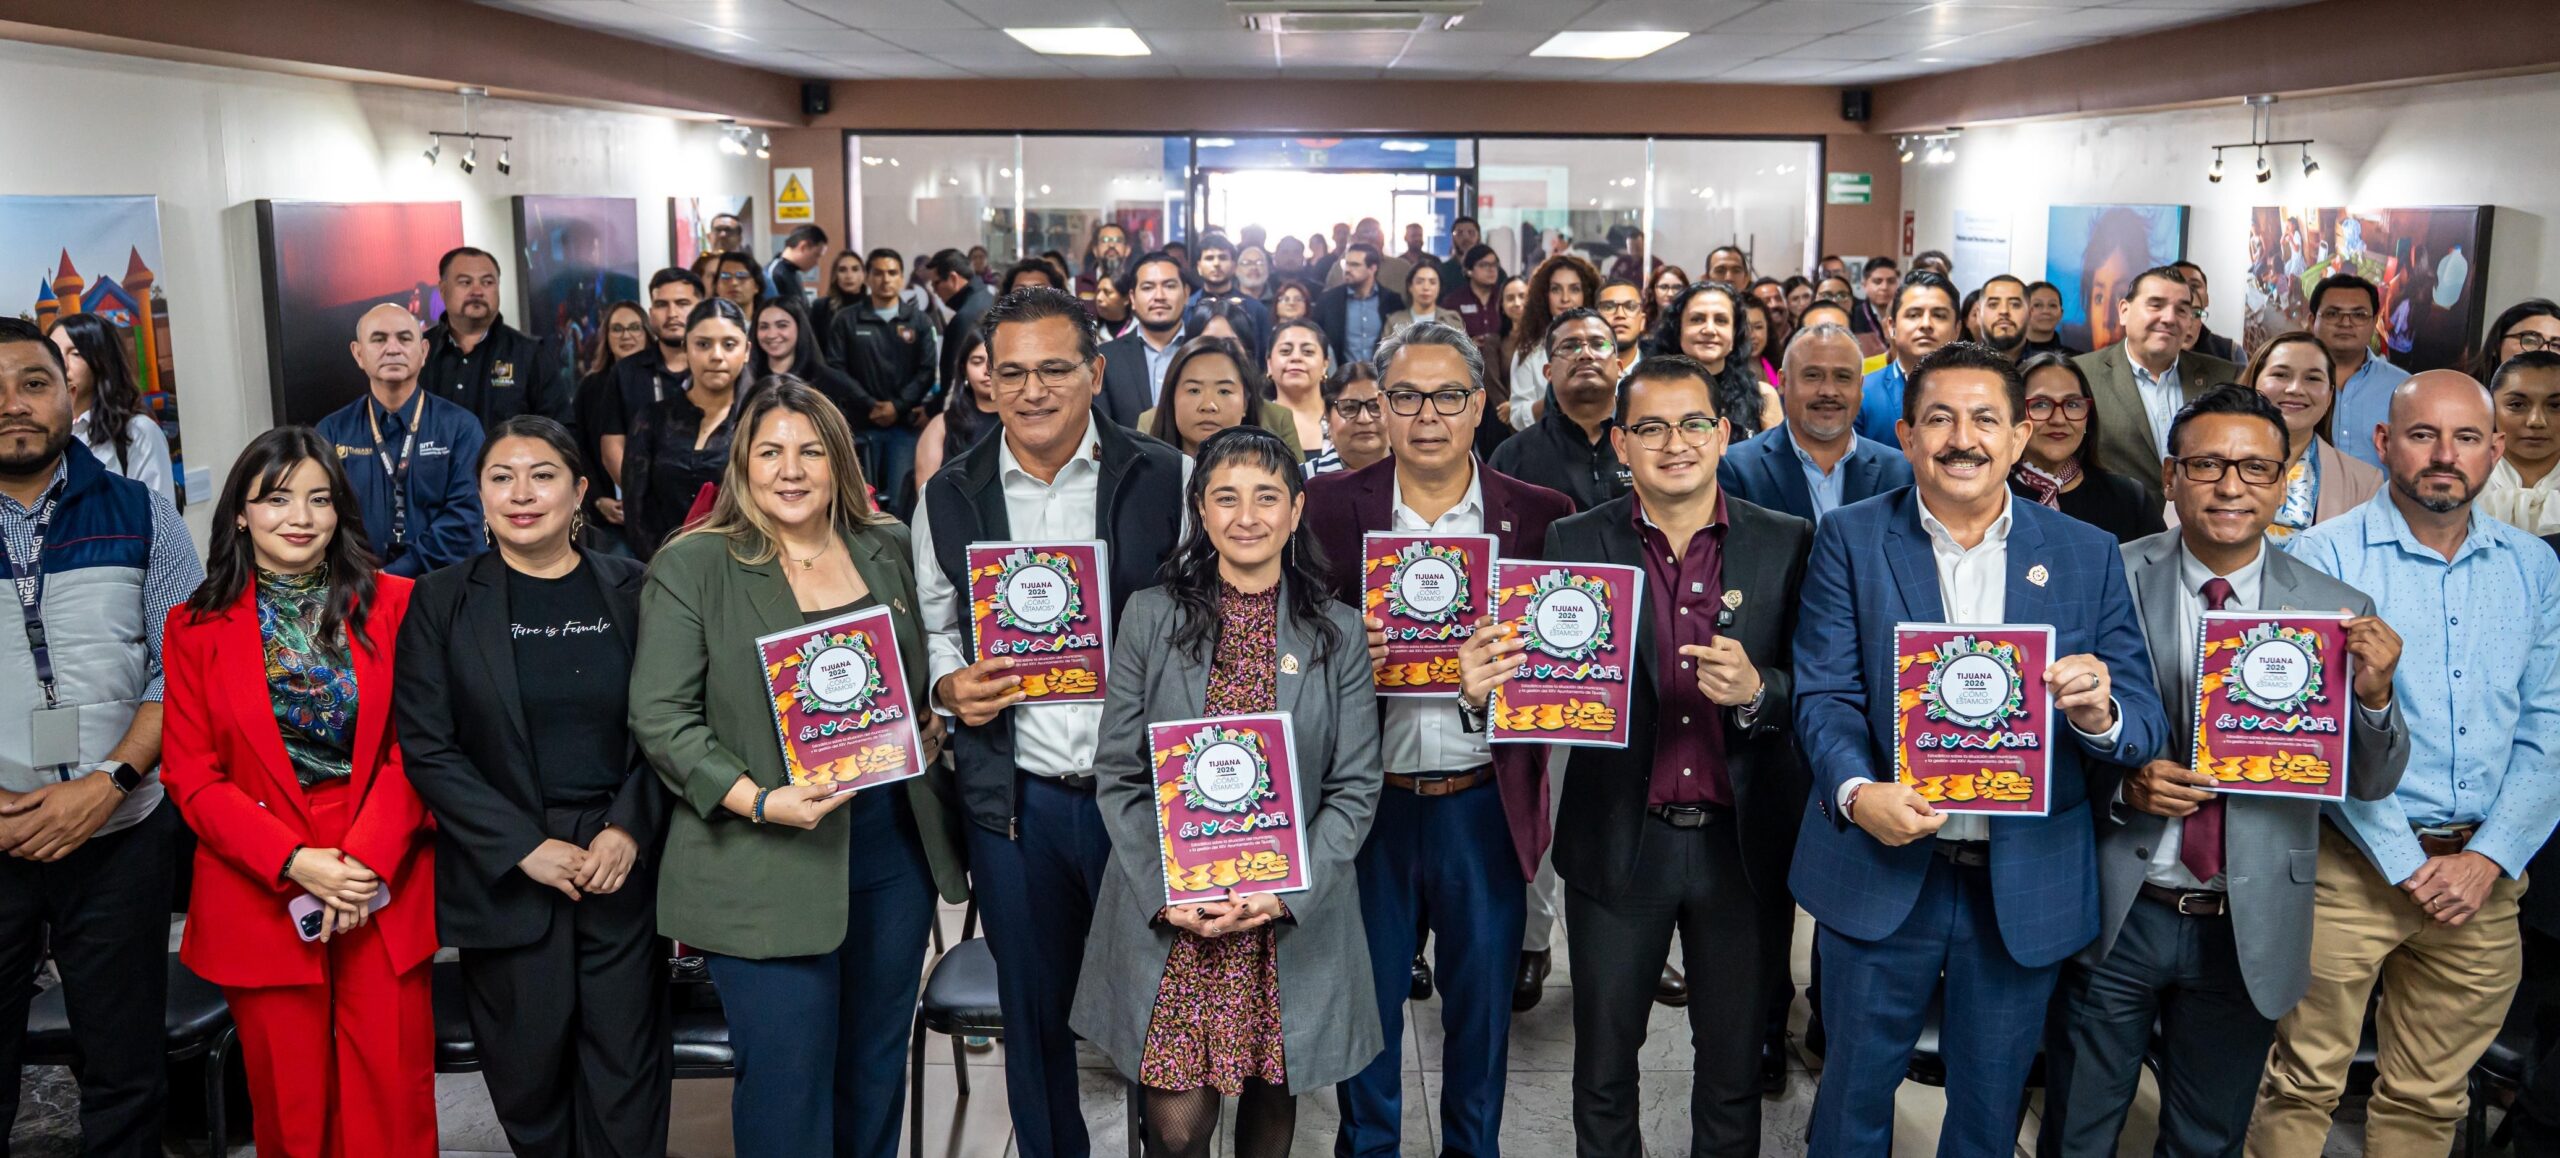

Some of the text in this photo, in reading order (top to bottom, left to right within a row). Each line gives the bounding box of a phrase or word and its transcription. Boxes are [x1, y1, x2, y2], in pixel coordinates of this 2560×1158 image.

[38, 499, 57, 525] INEGI
[29, 536, 44, 563] INEGI
[24, 576, 35, 606] INEGI
[1024, 599, 1050, 607] ¿CÓMO
[545, 626, 559, 637] is
[562, 617, 610, 636] Female
[1553, 624, 1579, 632] ¿CÓMO
[821, 660, 852, 672] TIJUANA
[829, 668, 846, 677] 2026
[1959, 691, 1988, 700] ¿CÓMO
[1209, 759, 1241, 767] TIJUANA
